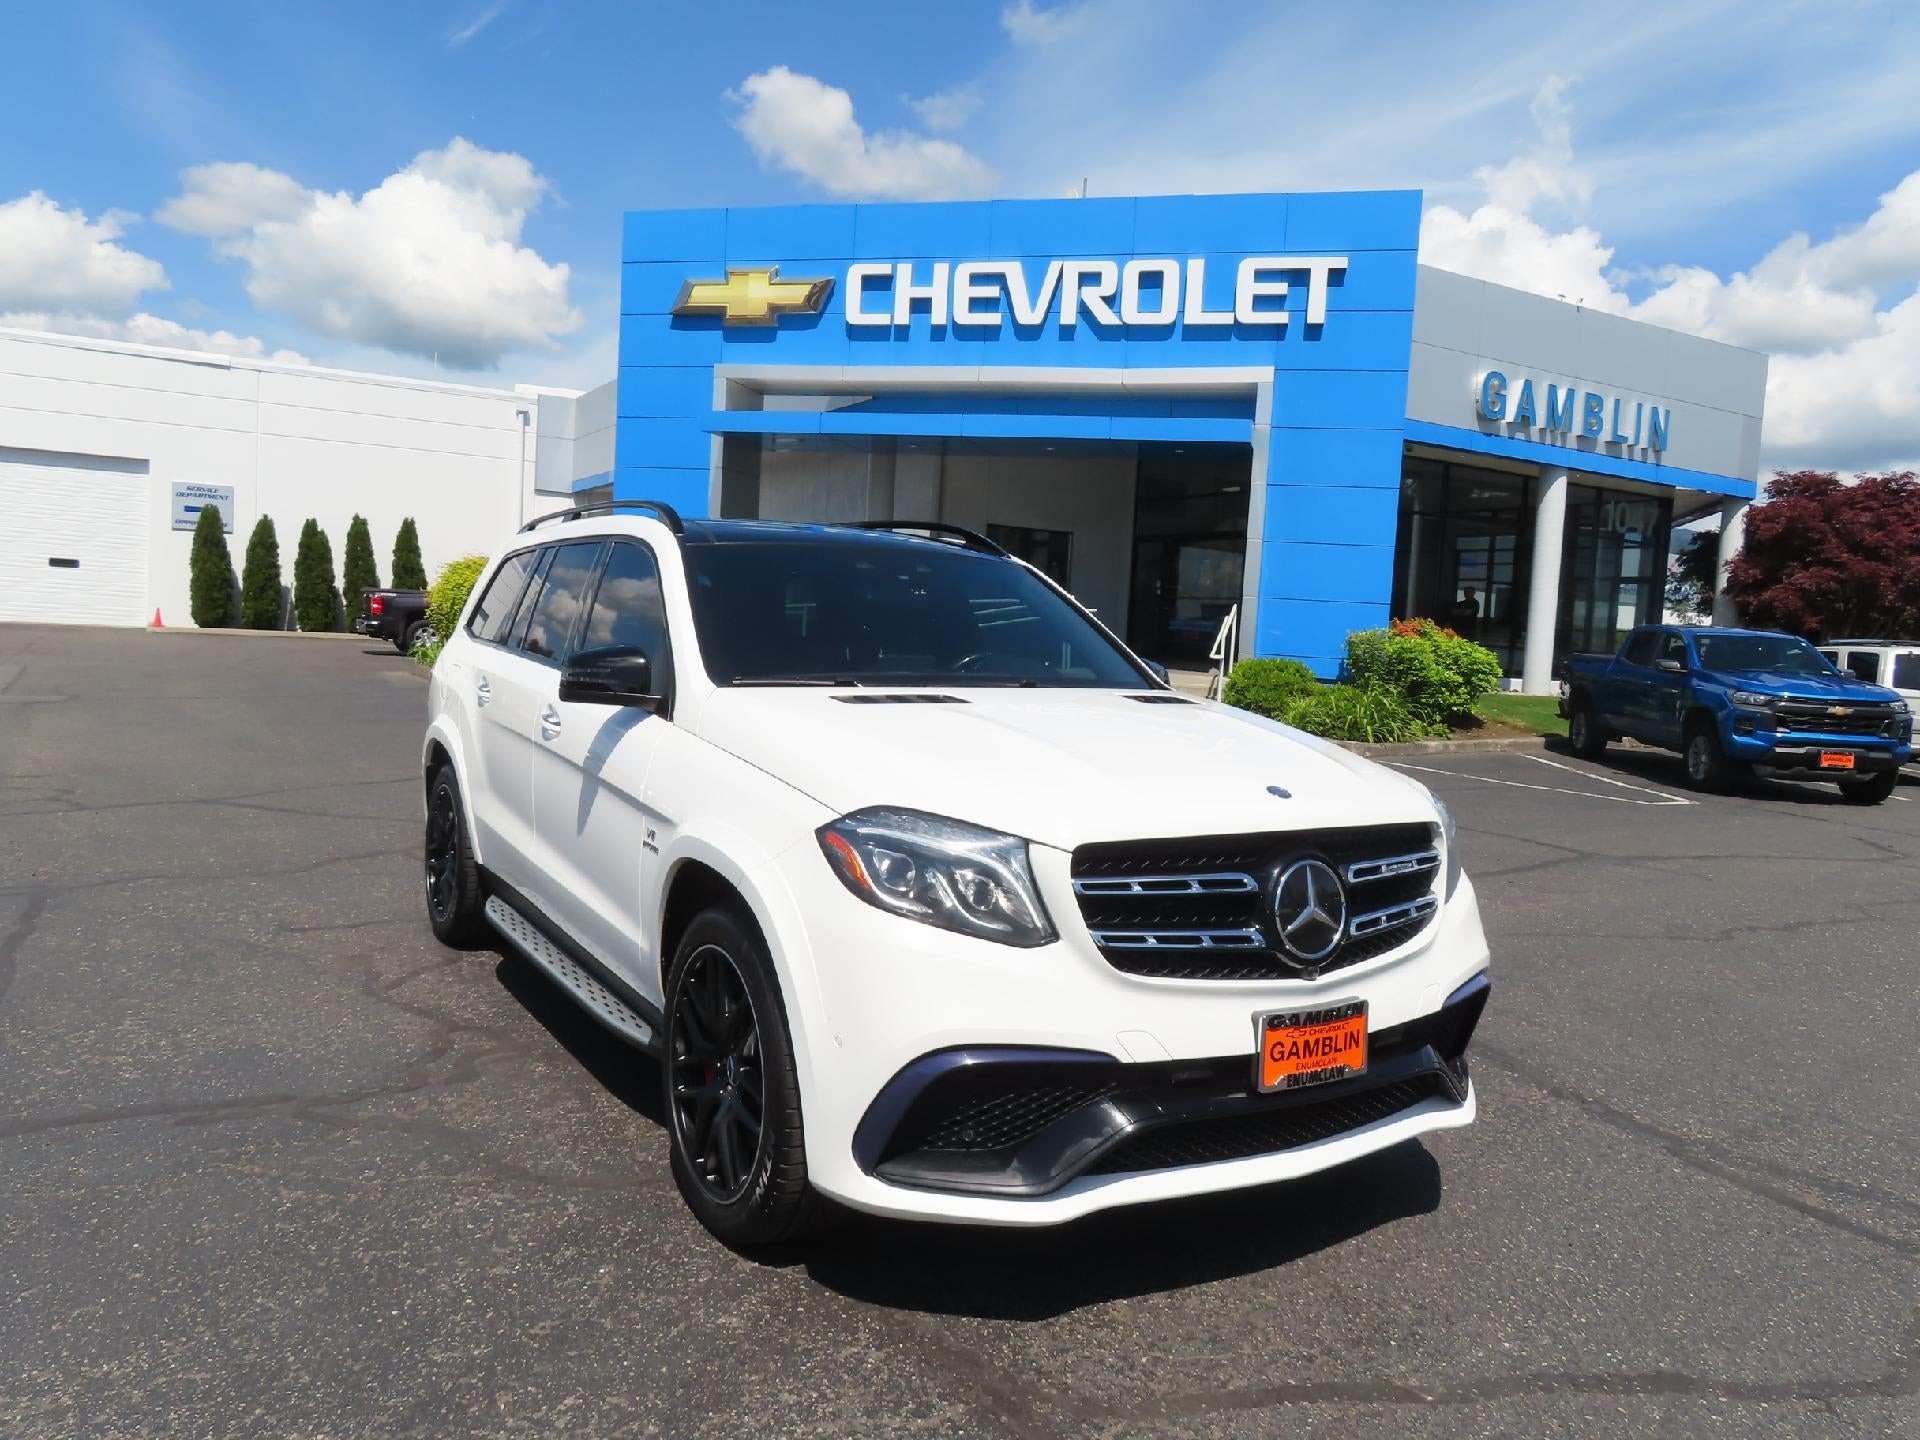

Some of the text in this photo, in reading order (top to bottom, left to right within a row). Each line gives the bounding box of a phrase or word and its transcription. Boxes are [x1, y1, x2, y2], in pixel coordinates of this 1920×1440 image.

[845, 256, 1348, 326] CHEVROLET
[1480, 370, 1671, 452] GAMBLIN
[175, 491, 230, 501] DEPARTMENT
[186, 485, 219, 494] SERVICE
[1309, 1022, 1350, 1036] CHEVROLET
[1269, 1029, 1360, 1063] GAMBLIN
[1295, 1056, 1338, 1071] ENUMCLAW
